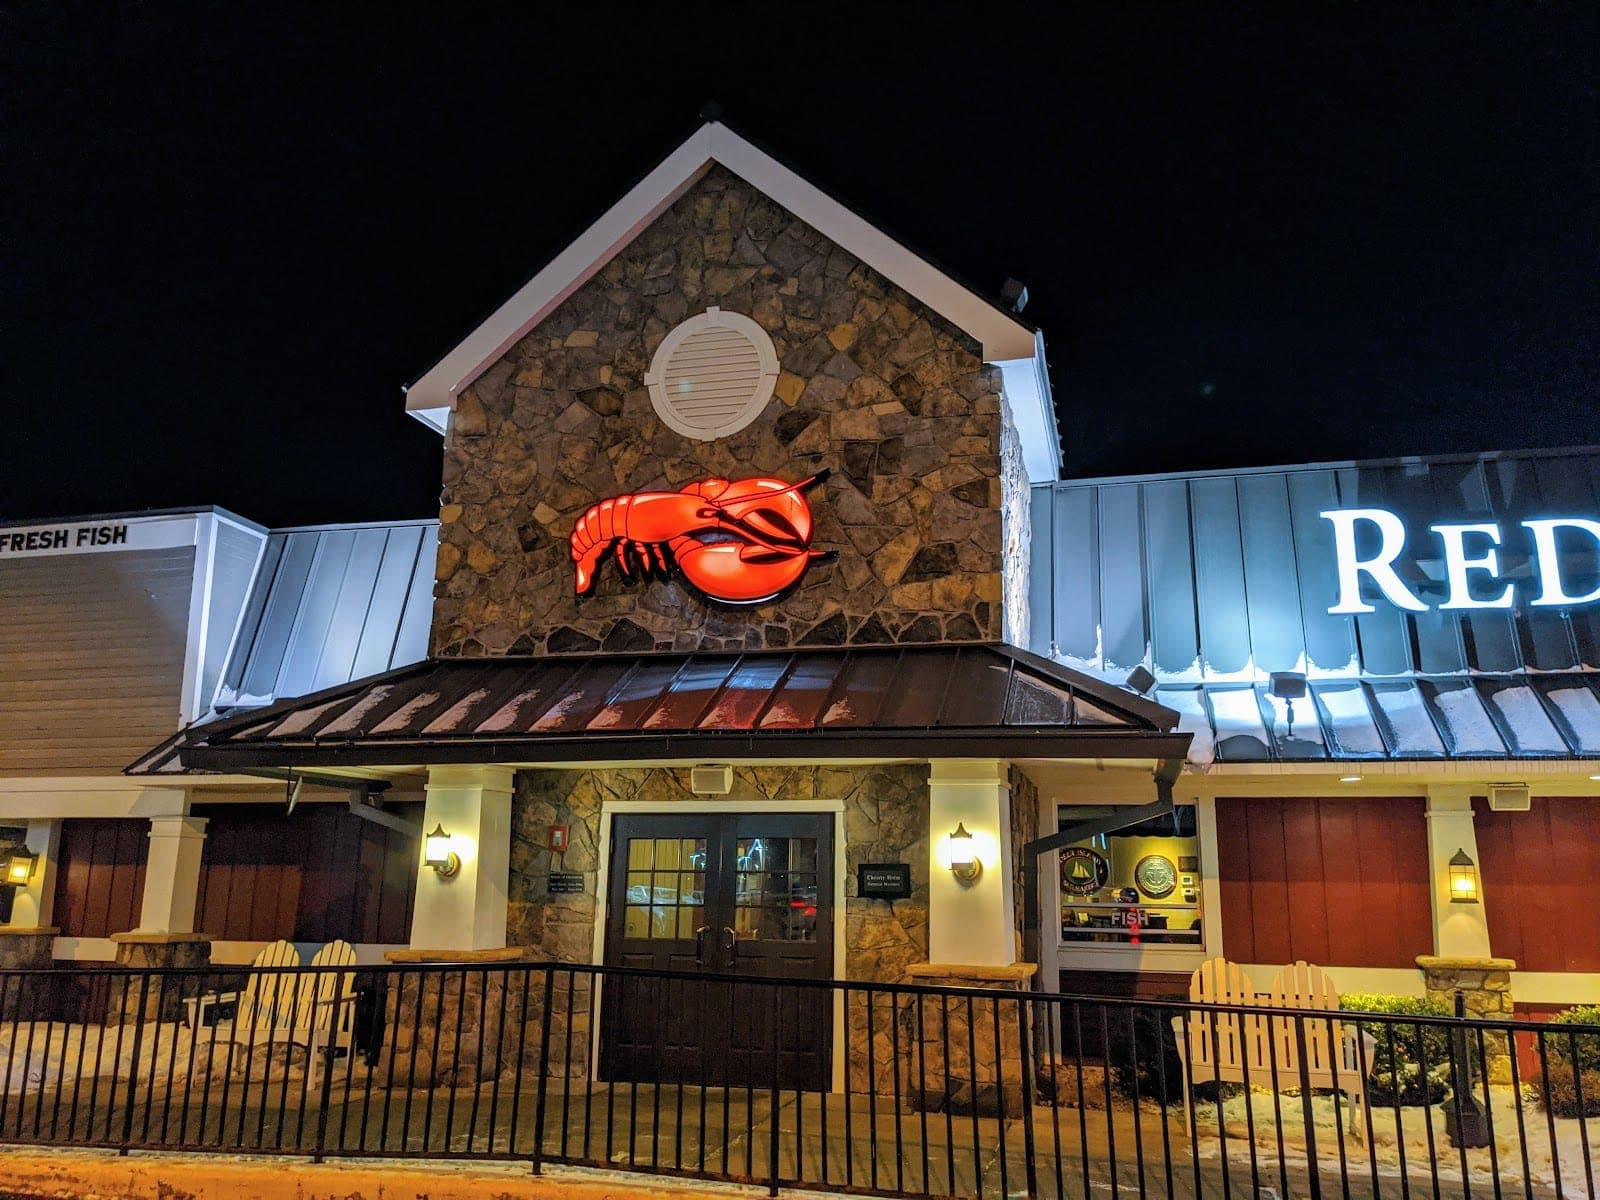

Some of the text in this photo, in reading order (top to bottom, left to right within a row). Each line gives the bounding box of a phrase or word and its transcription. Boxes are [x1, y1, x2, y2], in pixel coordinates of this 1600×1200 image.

[0, 525, 128, 552] FRESH FISH
[1319, 508, 1600, 615] RED
[1111, 911, 1149, 926] FISH
